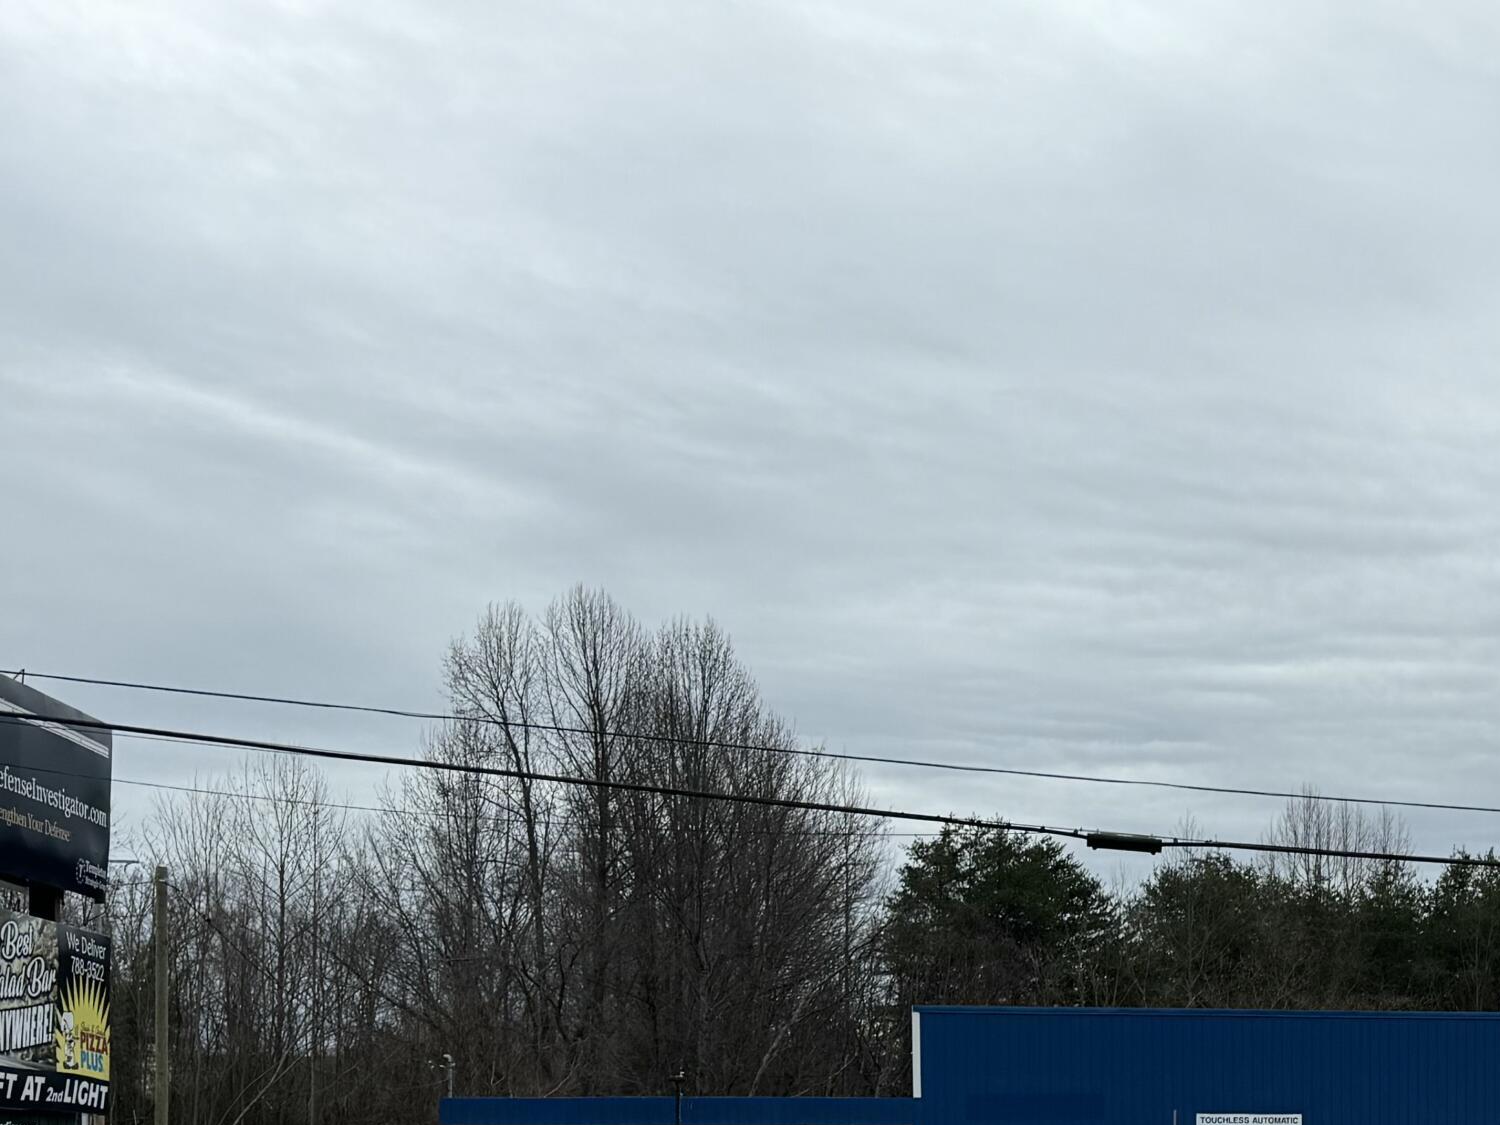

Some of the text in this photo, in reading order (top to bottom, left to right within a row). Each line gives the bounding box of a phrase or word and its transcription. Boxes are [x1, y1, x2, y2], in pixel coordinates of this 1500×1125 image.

[27, 812, 44, 833] Your
[45, 819, 71, 842] Defense
[0, 921, 33, 959] Best
[66, 931, 107, 960] We Deliver
[26, 956, 56, 997] Bar
[70, 955, 105, 982] 788-3522
[80, 1030, 108, 1056] PIZZA
[80, 1050, 104, 1072] PLUS
[20, 1075, 46, 1102] AT
[45, 1086, 64, 1103] 2nd
[63, 1078, 109, 1110] LIGHT
[1200, 1116, 1299, 1125] TOUCHLESS AUTOMATIC
